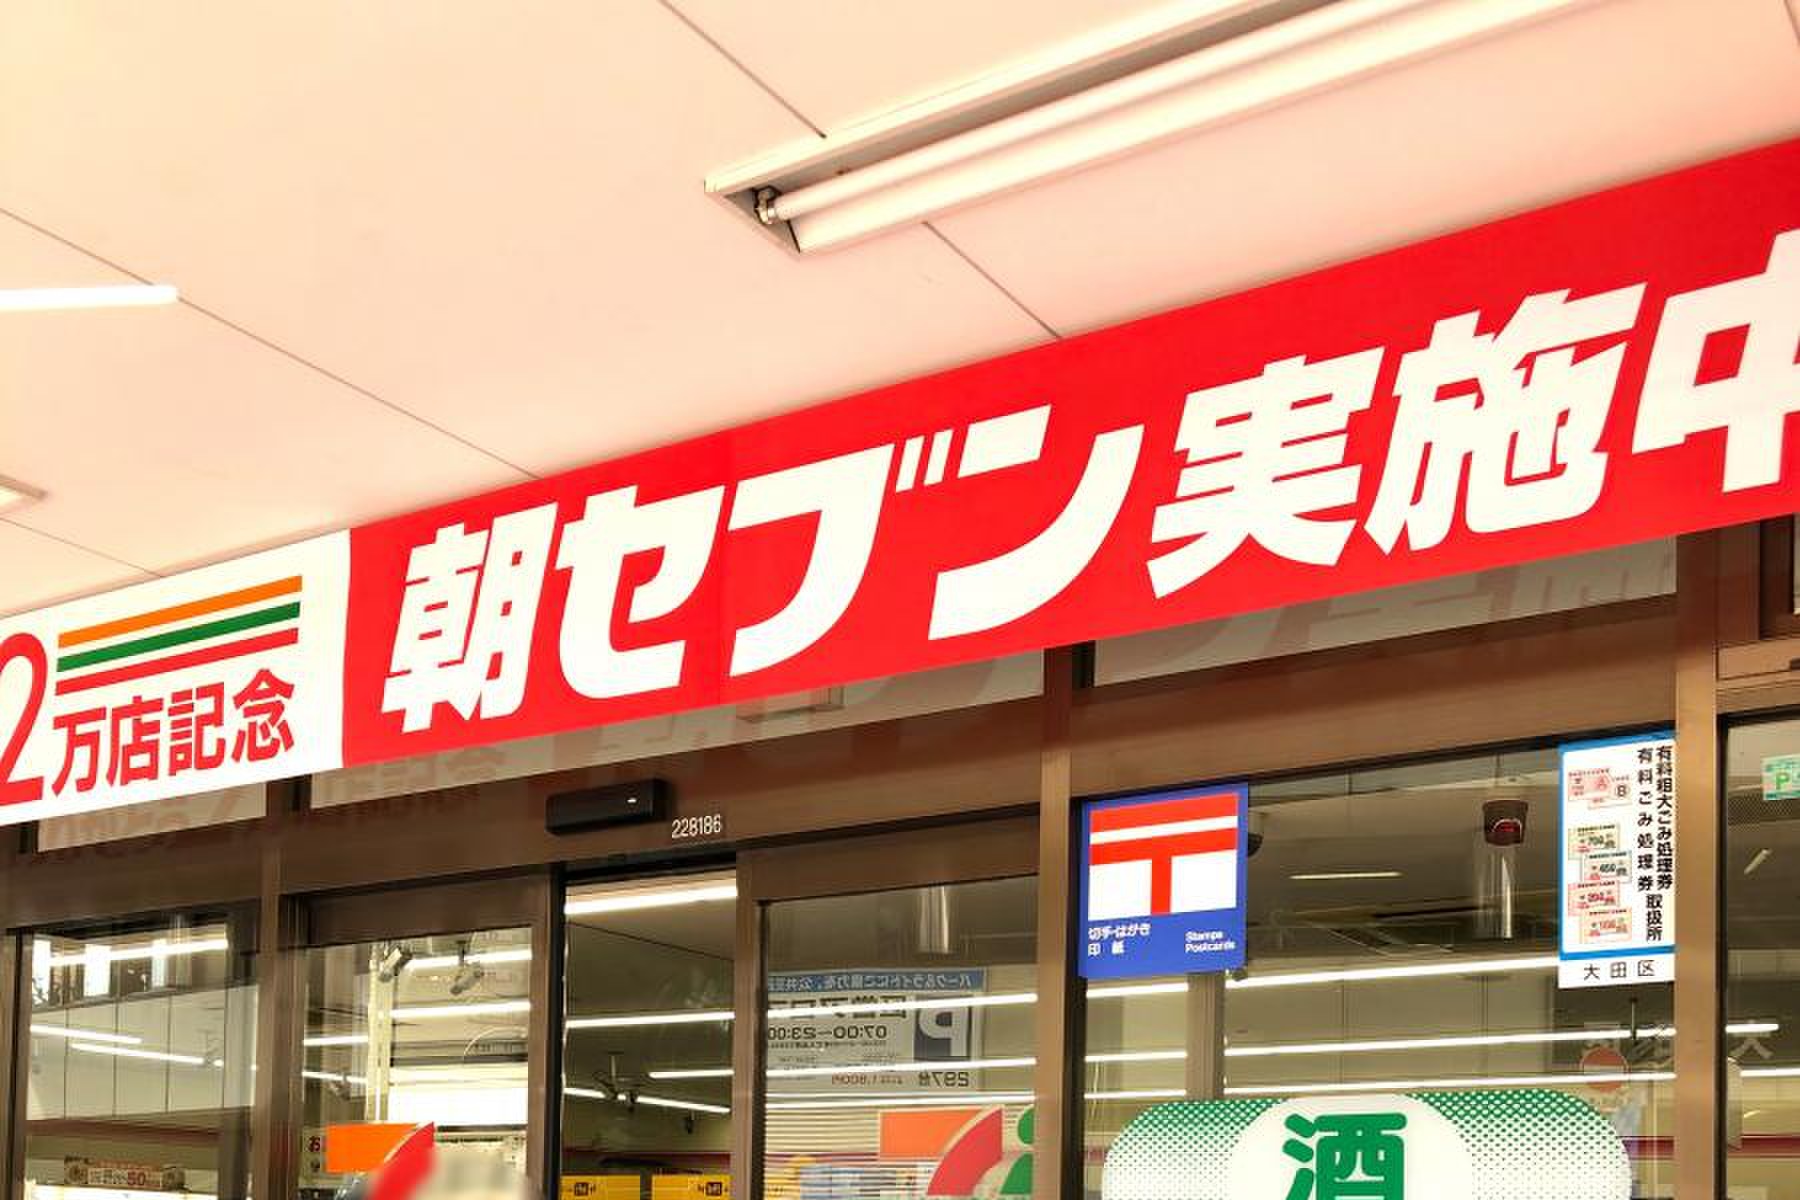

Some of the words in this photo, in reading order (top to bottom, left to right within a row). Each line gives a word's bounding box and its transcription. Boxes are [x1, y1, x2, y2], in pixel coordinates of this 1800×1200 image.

[380, 228, 1800, 734] 朝セブン実施中
[671, 814, 722, 839] 228186
[1637, 747, 1654, 892] 有料ごみ処理券
[1645, 893, 1664, 943] 取扱所
[1583, 960, 1656, 980] 大田区
